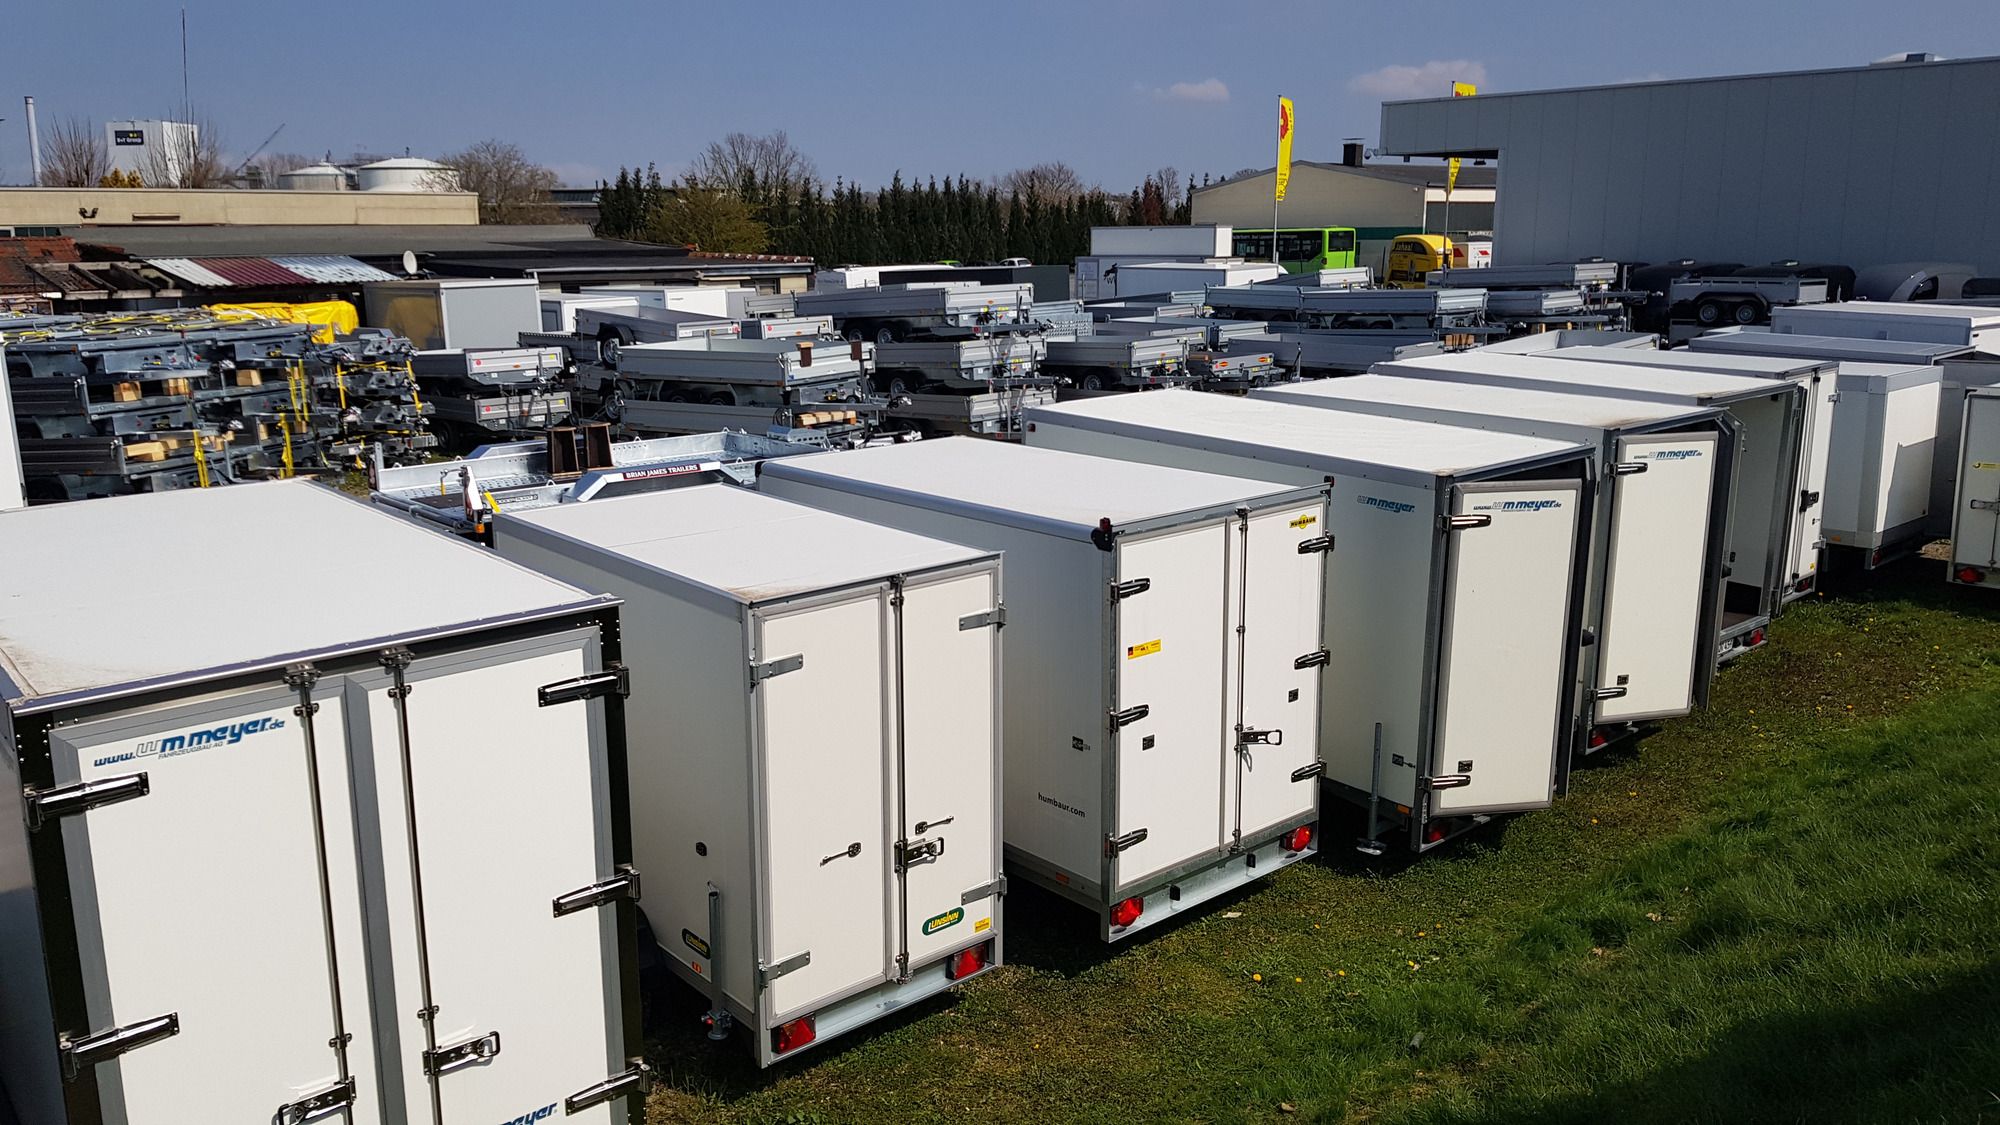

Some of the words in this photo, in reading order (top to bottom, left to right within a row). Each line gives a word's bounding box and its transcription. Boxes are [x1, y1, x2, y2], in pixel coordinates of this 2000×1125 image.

[625, 471, 646, 479] BRIAN
[646, 469, 667, 477] JAMES
[667, 465, 698, 474] TRAILERS
[158, 743, 211, 760] FAHRZEUGBAU
[1037, 791, 1086, 818] humbaur.com
[498, 1102, 558, 1125] eyer
